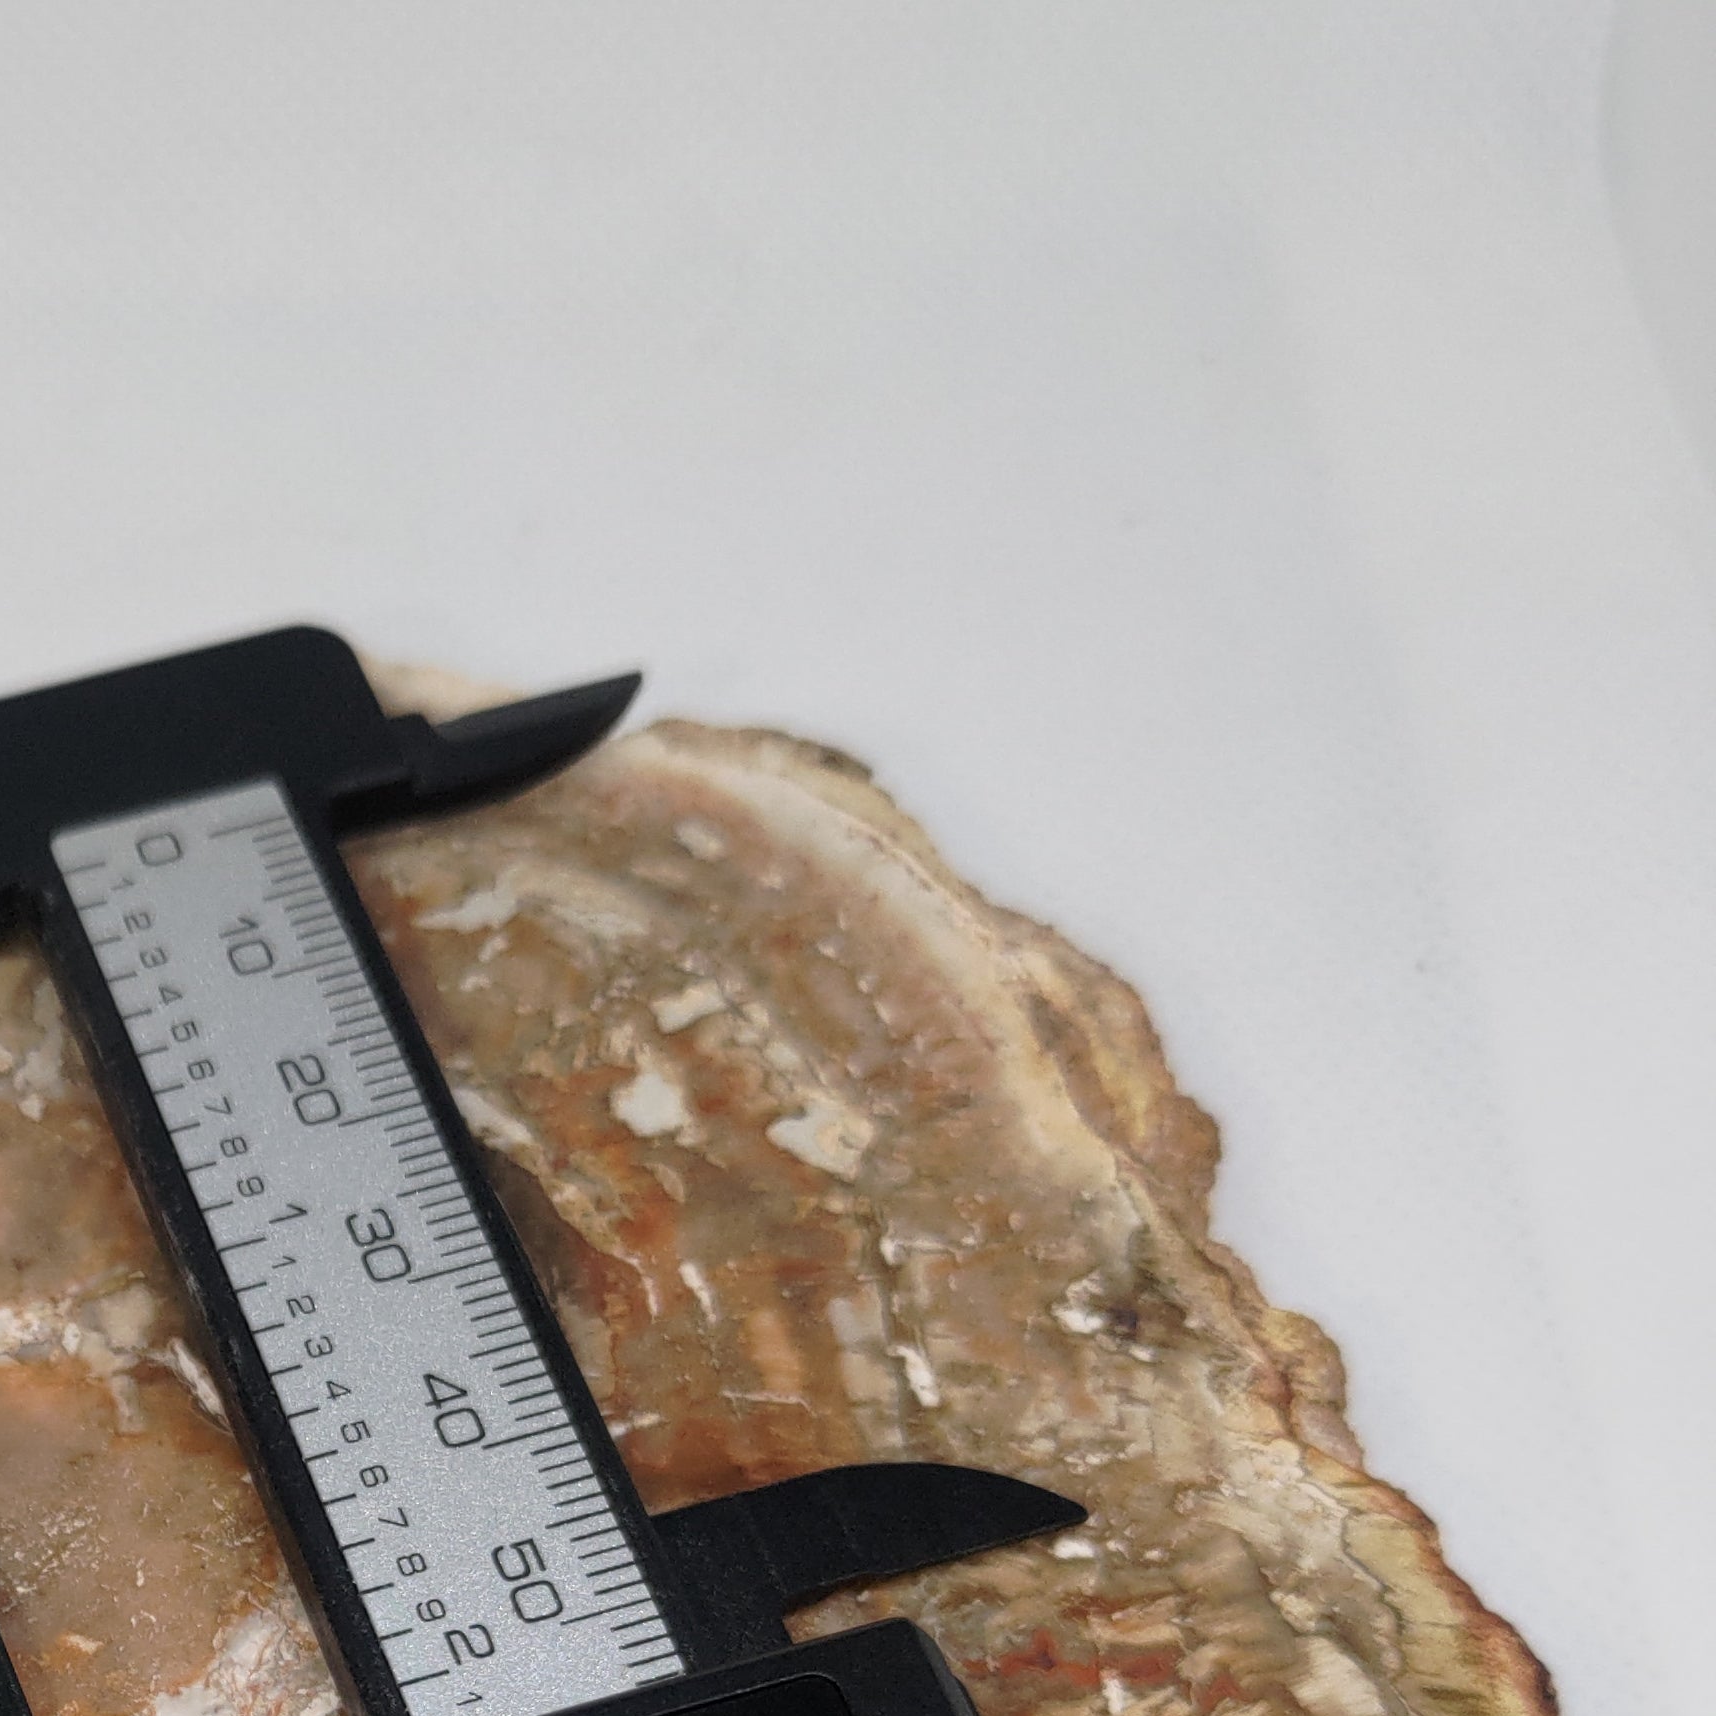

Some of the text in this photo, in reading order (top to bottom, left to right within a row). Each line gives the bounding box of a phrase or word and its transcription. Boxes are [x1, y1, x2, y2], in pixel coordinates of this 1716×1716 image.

[110, 876, 496, 1707] 1 2 3 4 5 6 7 8 9 1 1 2 3 4 5 6 7 8 9 2 1
[135, 831, 563, 1626] 0 10 20 30 40 50
